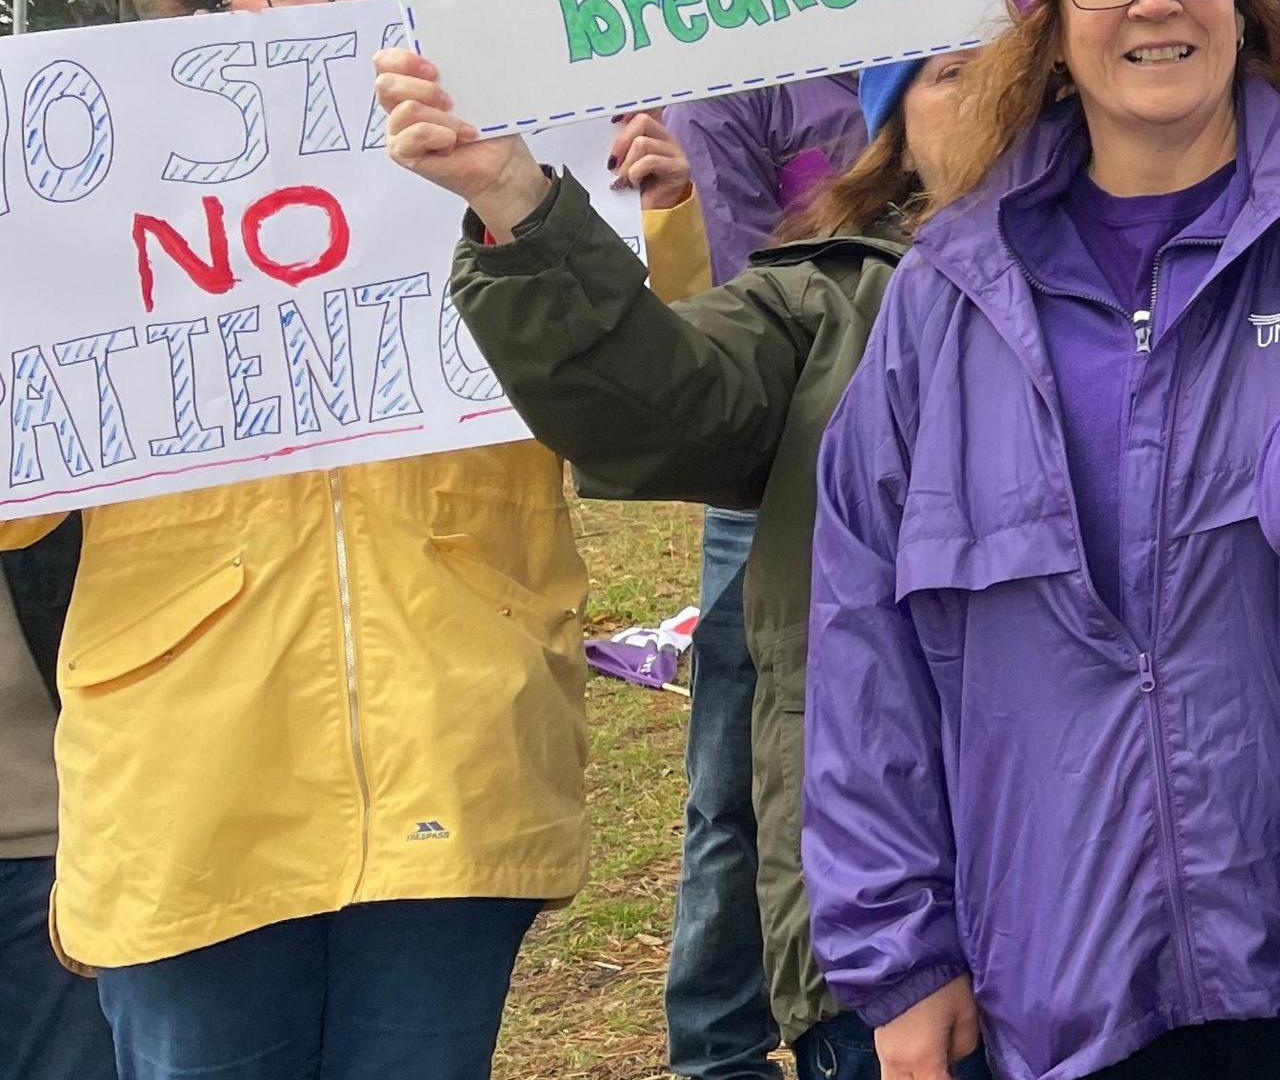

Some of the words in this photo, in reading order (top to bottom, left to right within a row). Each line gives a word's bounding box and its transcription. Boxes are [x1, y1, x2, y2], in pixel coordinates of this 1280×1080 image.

[0, 60, 115, 203] O
[131, 184, 350, 312] NO
[0, 271, 431, 488] ATIENT
